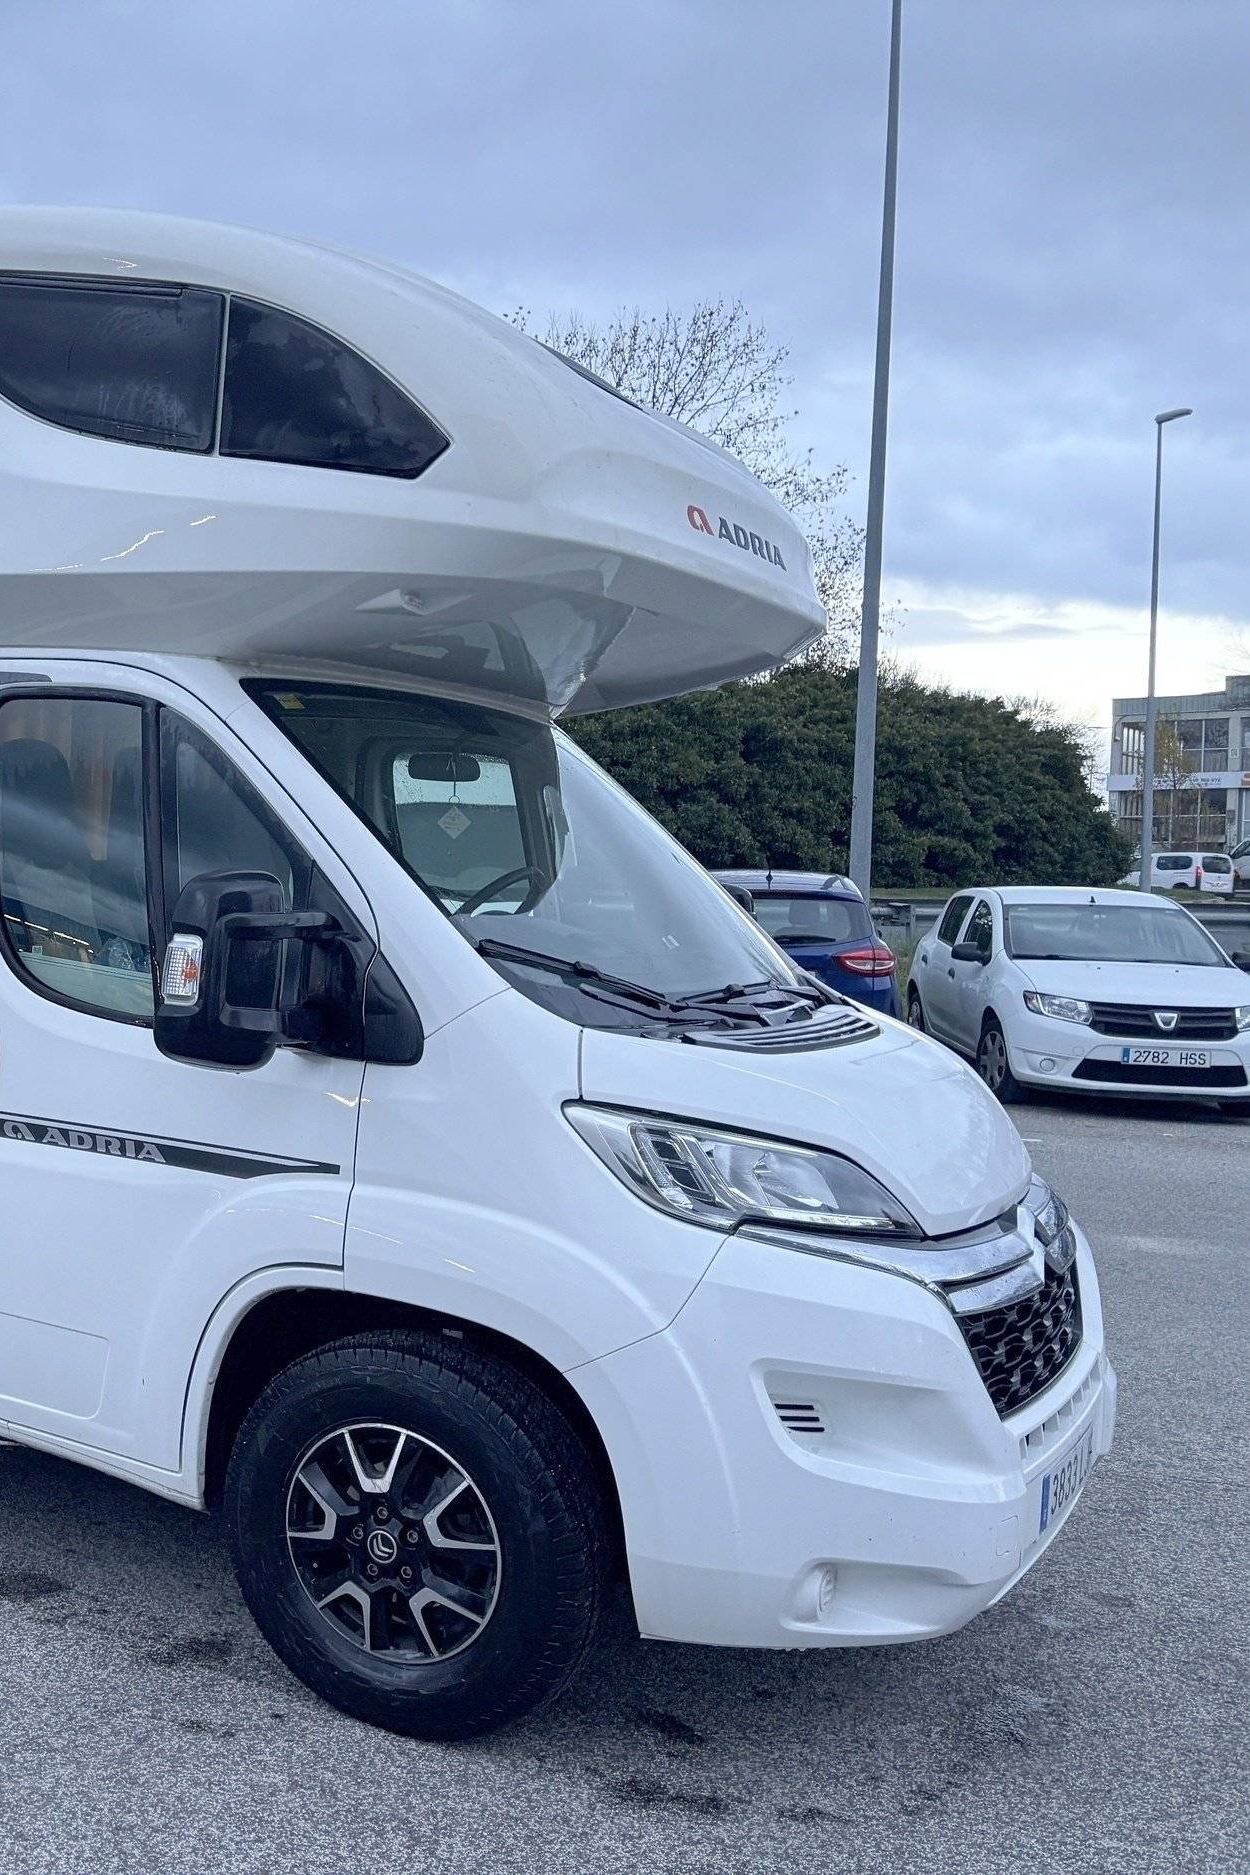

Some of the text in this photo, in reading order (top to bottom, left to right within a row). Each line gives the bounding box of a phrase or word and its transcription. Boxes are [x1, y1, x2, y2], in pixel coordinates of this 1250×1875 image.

[718, 516, 788, 572] ADRIA
[1133, 1050, 1207, 1066] 2782 HSS
[41, 1127, 167, 1163] ADRIA
